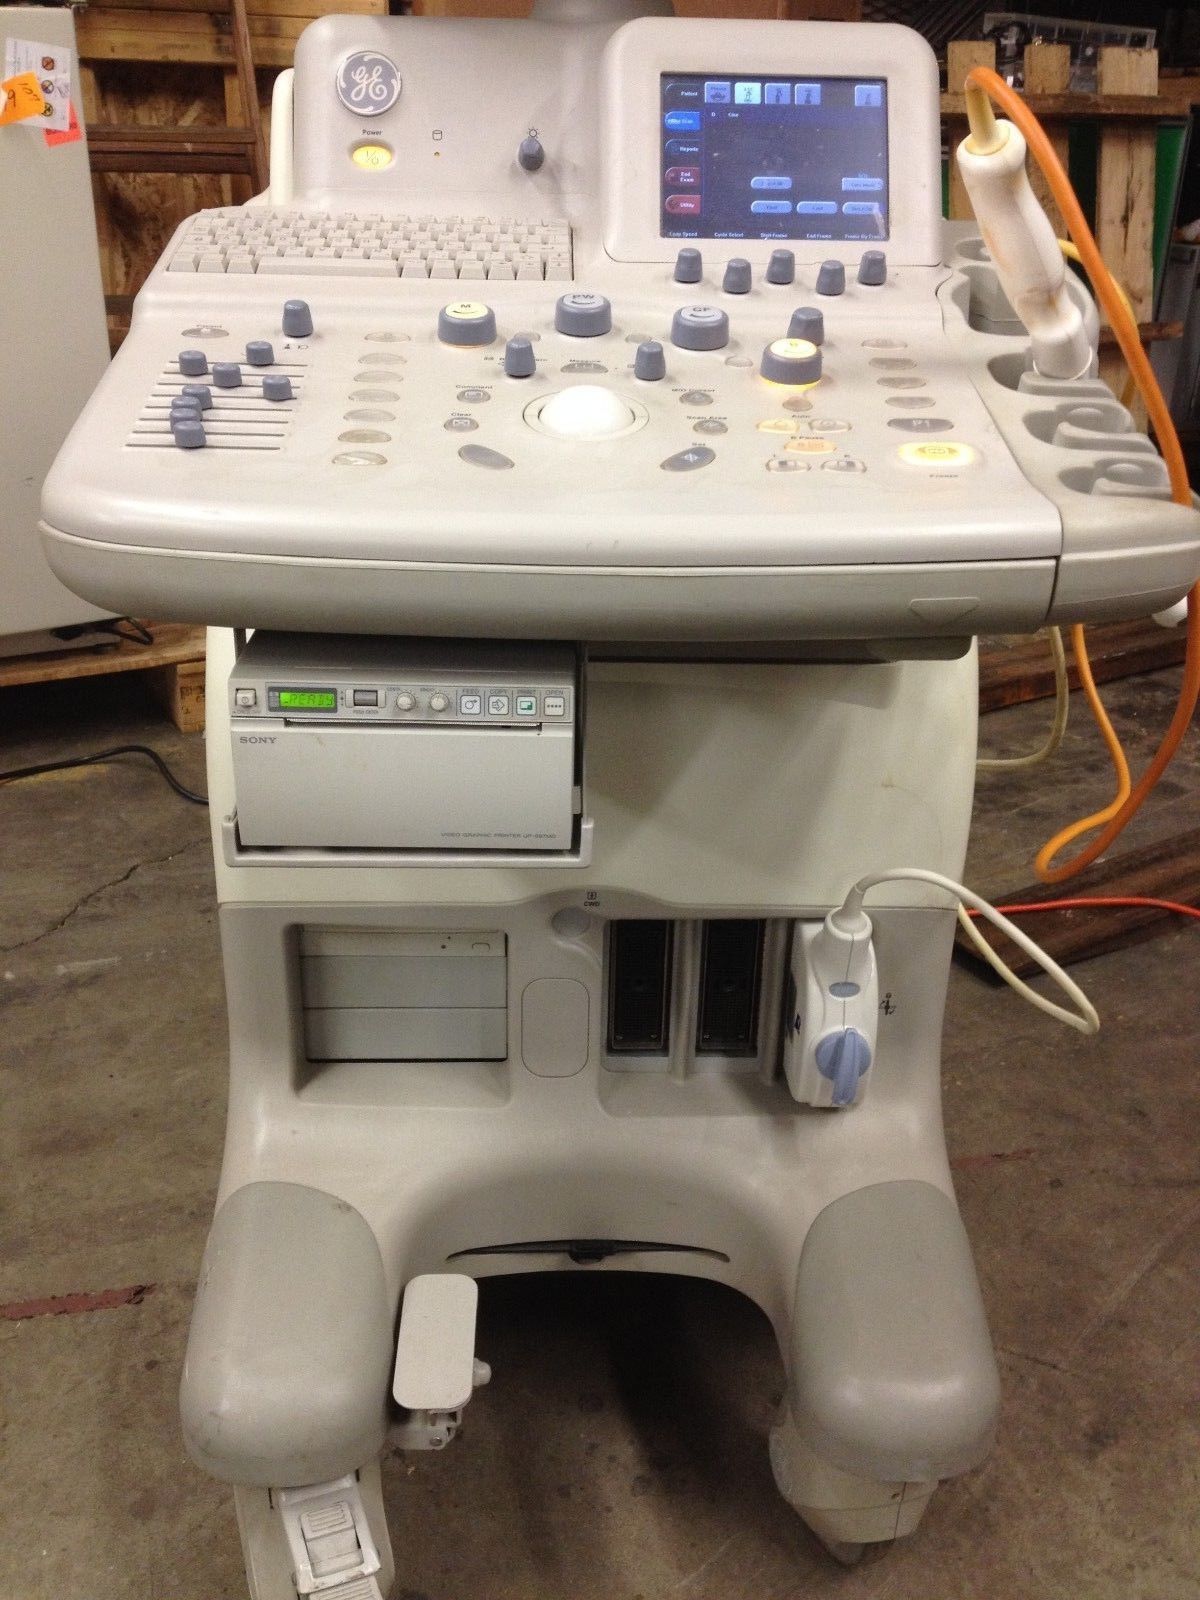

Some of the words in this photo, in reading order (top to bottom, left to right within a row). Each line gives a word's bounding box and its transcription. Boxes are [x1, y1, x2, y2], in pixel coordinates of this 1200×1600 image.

[350, 65, 388, 101] GE
[362, 128, 382, 136] Power
[239, 736, 277, 744] SONY
